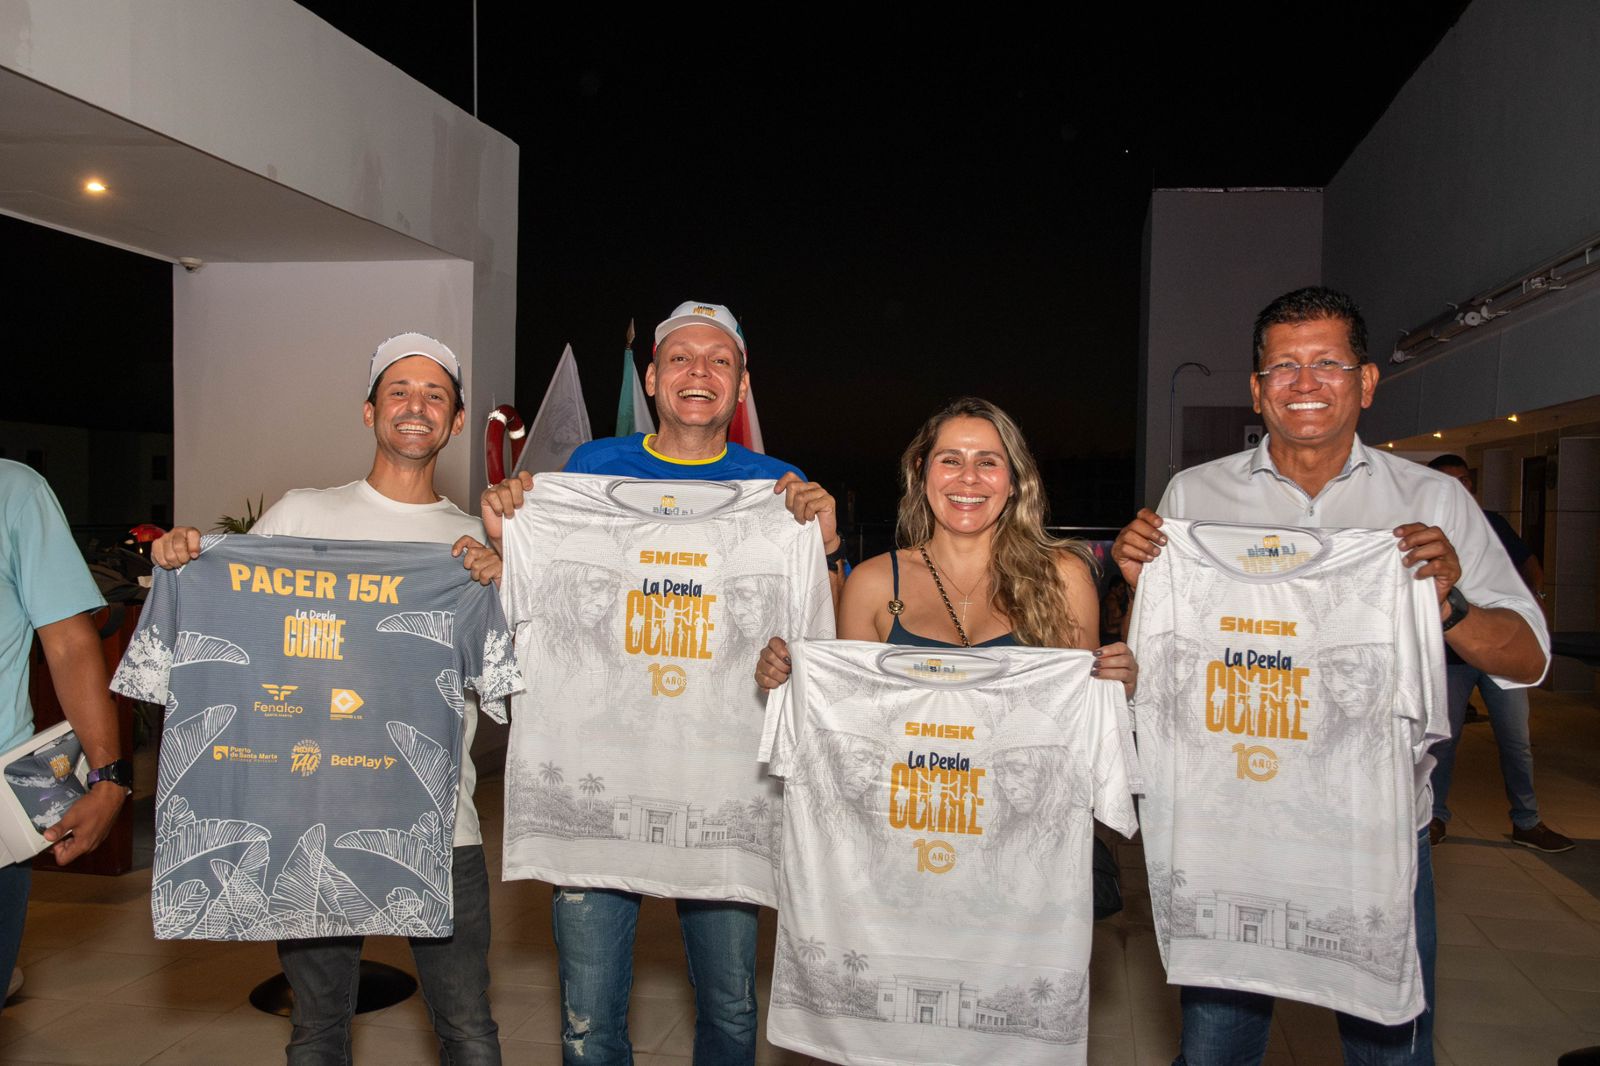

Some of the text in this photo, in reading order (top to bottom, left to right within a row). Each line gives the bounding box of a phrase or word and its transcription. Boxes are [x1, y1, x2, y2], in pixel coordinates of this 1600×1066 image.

[228, 562, 405, 604] PACER 15K
[643, 578, 702, 598] La Perla
[295, 608, 337, 622] La Perla
[625, 589, 717, 660] CORRE
[283, 615, 346, 661] CORRE
[1224, 647, 1292, 671] La Perla
[647, 662, 687, 698] 10
[254, 701, 304, 714] Fenalco
[1205, 660, 1310, 741] CORRE
[230, 746, 251, 754] Puerto
[330, 754, 382, 770] BetPlay
[908, 751, 970, 772] La Perla
[1232, 742, 1279, 782] 10
[889, 762, 986, 836] CORRE
[912, 838, 957, 874] 10
